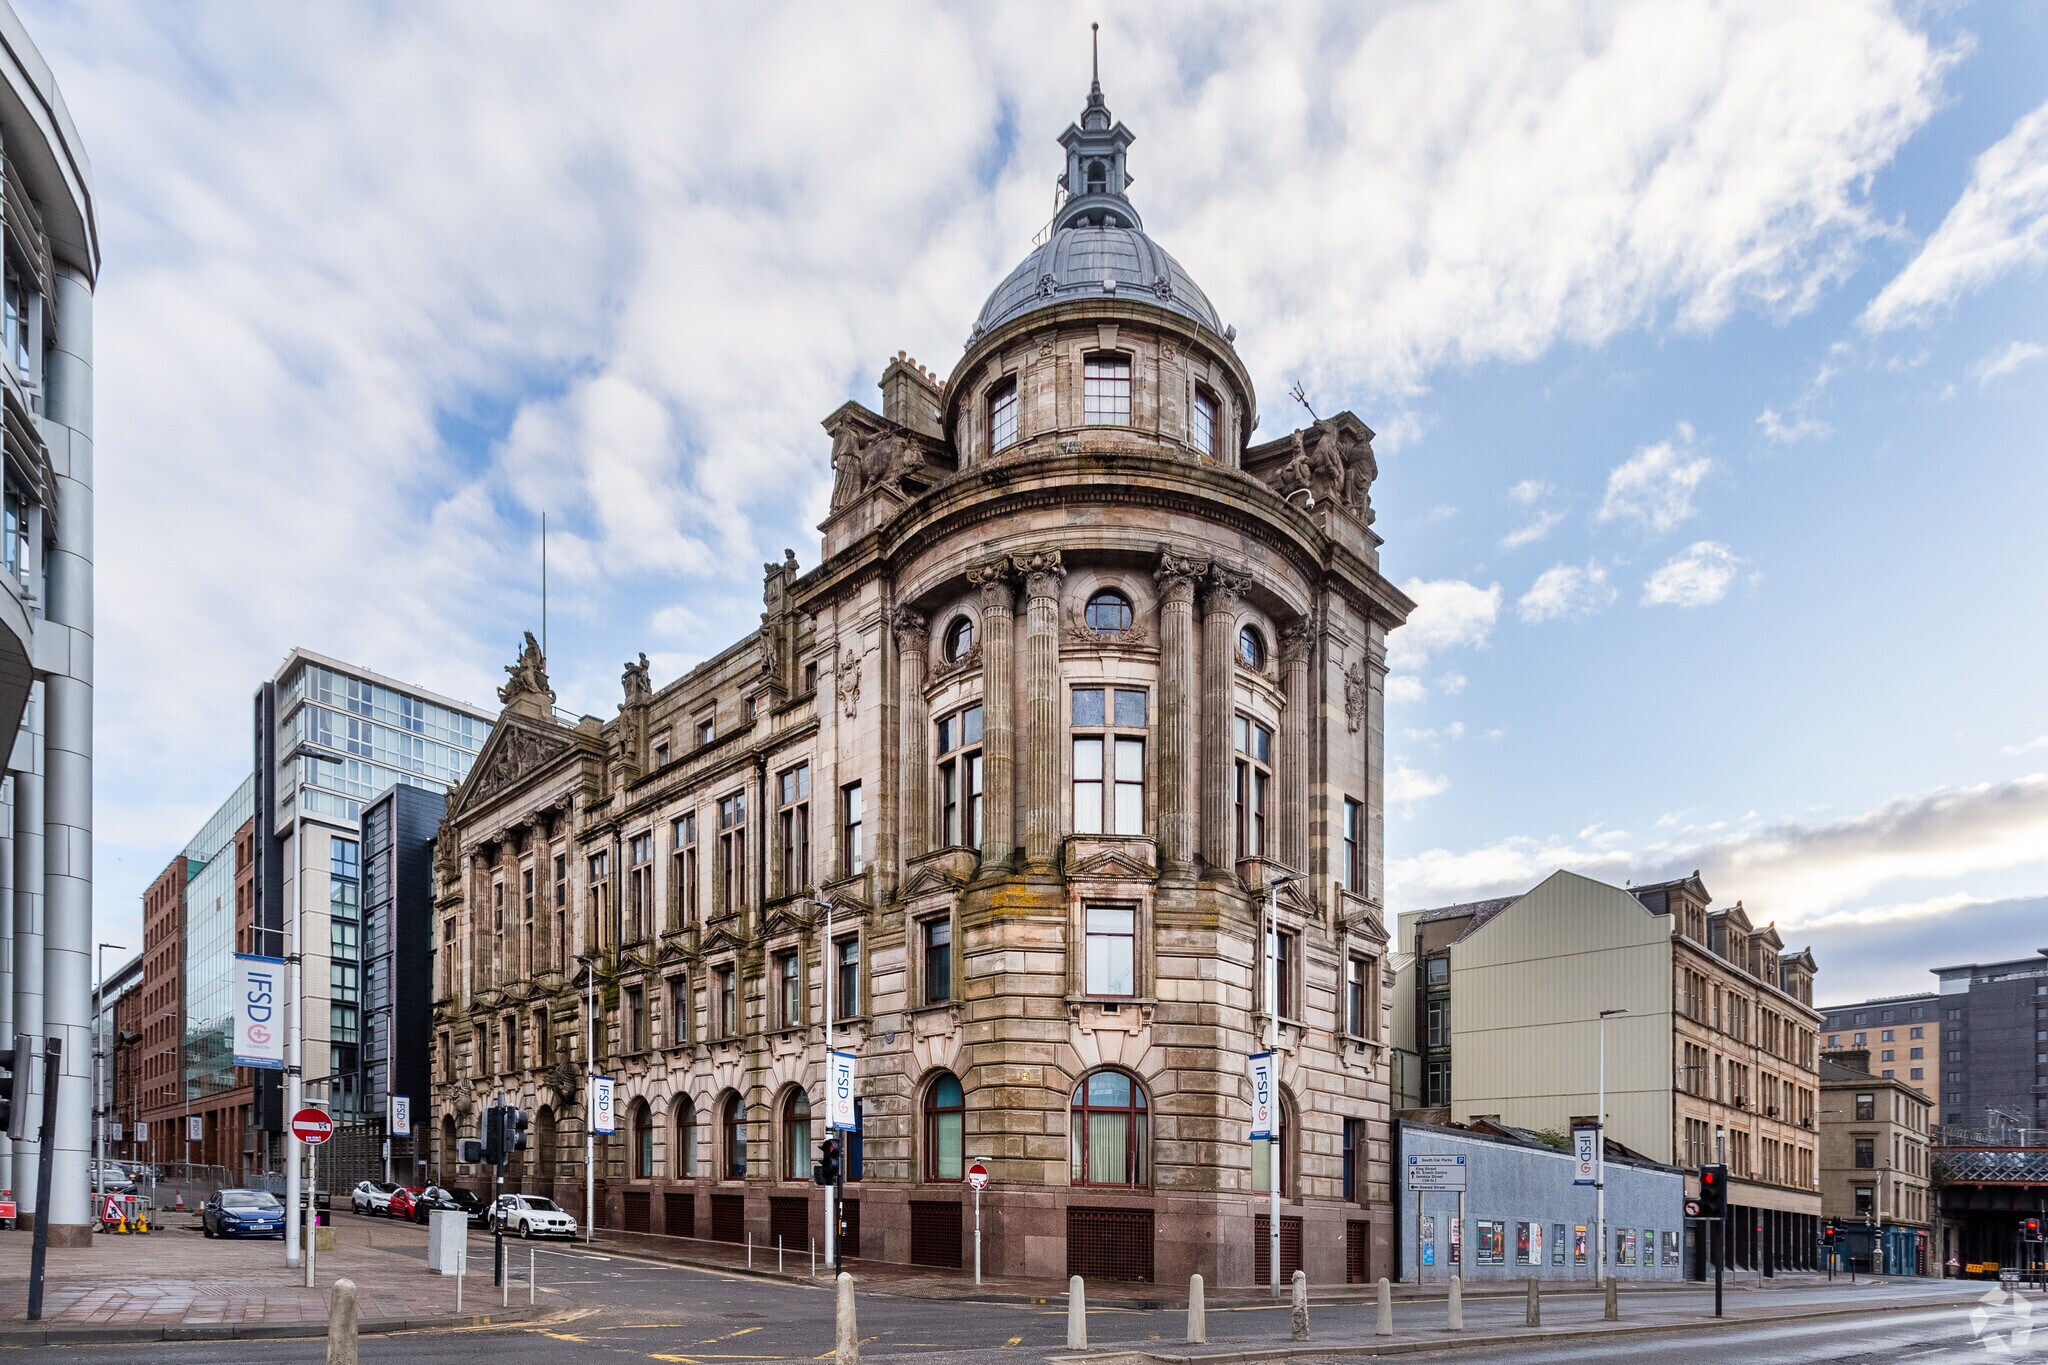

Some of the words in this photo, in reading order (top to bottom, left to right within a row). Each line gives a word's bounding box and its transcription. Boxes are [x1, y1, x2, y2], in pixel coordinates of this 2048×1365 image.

[247, 972, 272, 1023] IFSD
[838, 1064, 849, 1099] IFSD
[1255, 1066, 1268, 1105] IFSD
[396, 1101, 406, 1120] IFSD
[599, 1085, 609, 1111] IFSD
[1580, 1136, 1591, 1162] IFSD
